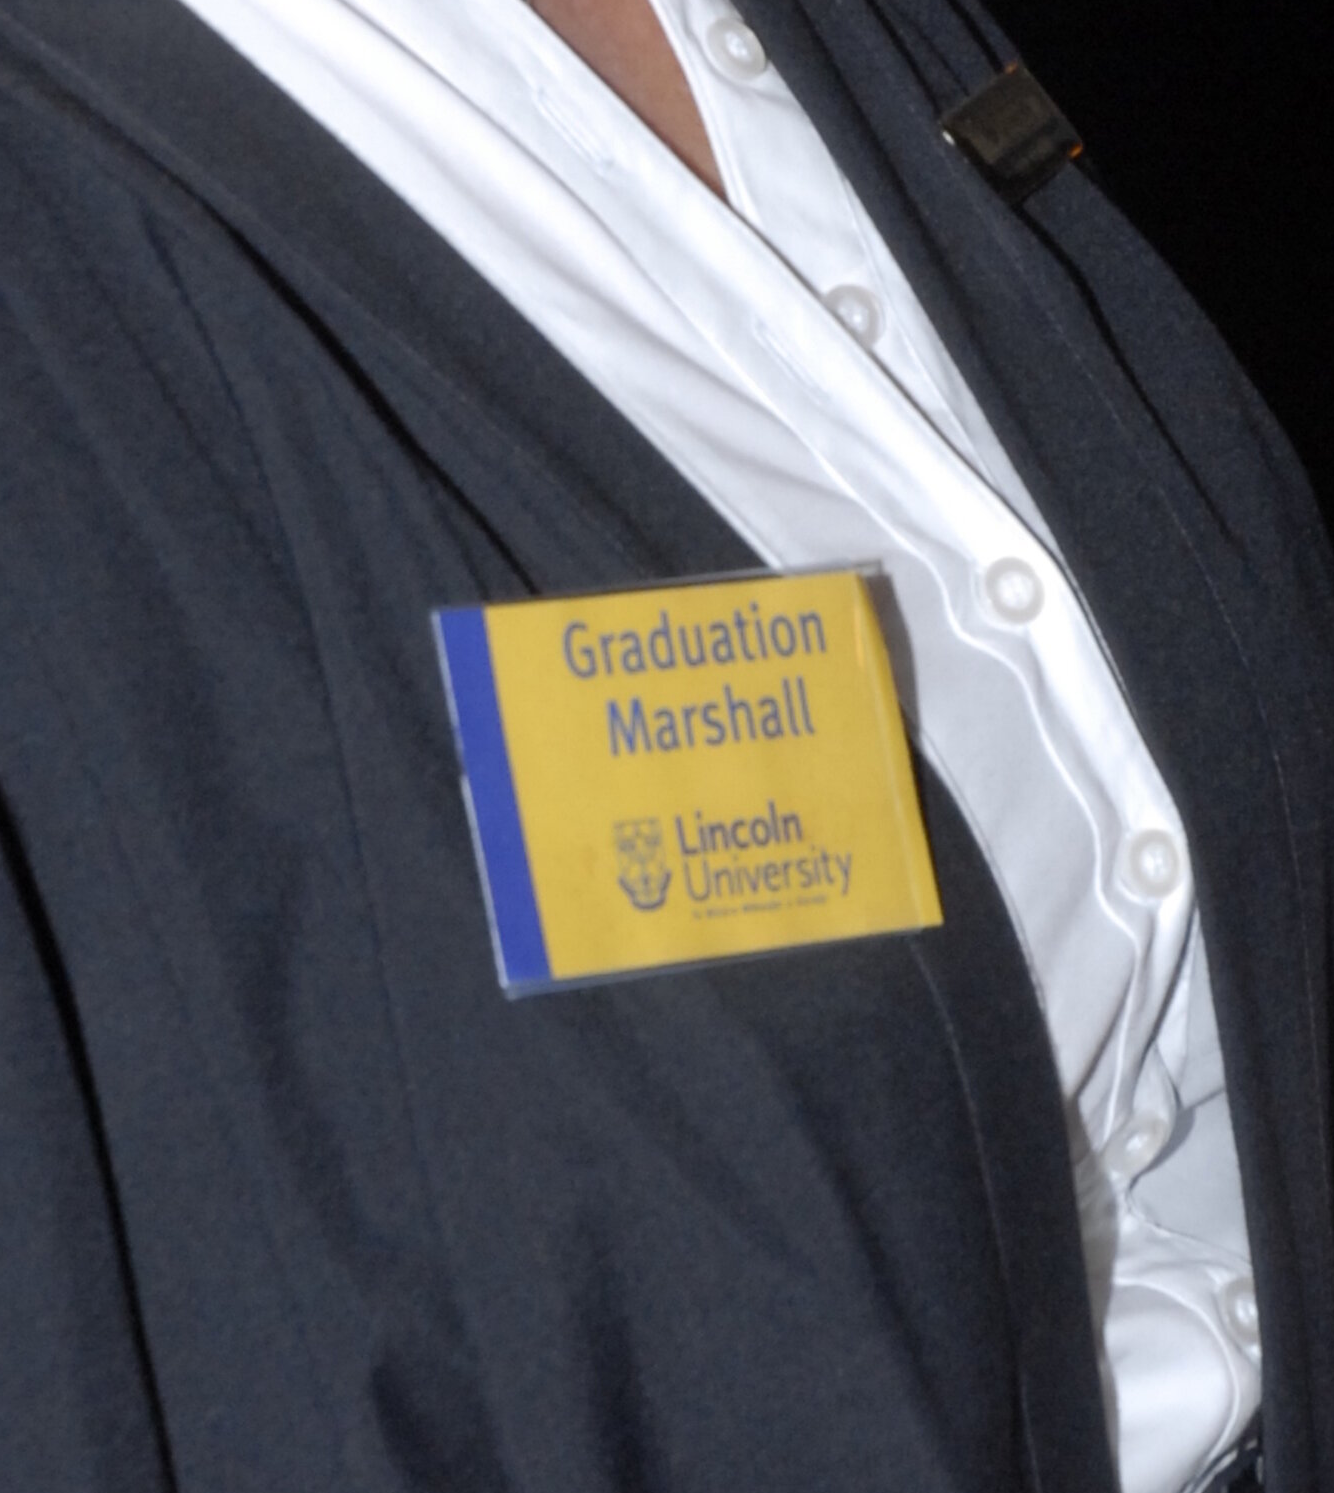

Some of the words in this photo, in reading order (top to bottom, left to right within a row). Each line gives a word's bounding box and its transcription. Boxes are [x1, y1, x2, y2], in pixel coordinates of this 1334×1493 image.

[562, 601, 828, 681] Graduation
[606, 676, 817, 757] Marshall
[674, 799, 804, 856] Lincoln
[682, 844, 854, 903] University
